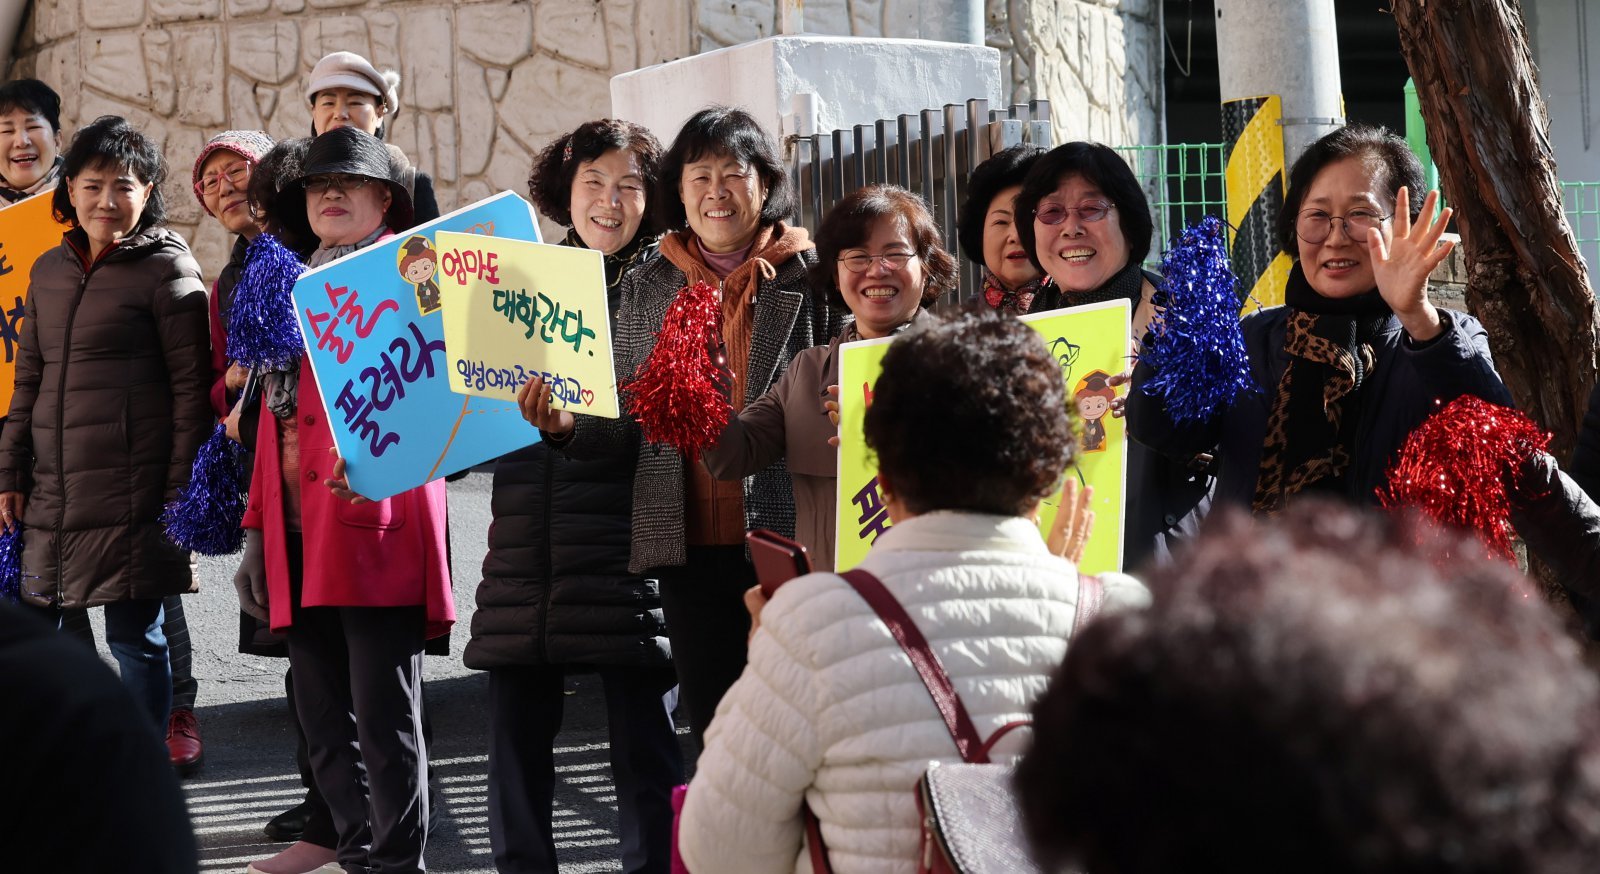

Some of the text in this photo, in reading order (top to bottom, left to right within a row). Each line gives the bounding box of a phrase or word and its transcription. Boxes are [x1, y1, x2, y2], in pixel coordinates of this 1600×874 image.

[442, 248, 500, 285] 엄마도
[305, 282, 399, 364] 술술
[492, 288, 596, 357] 대학간다.
[334, 322, 446, 458] 풀려라
[456, 359, 581, 408] 일성여자등학교
